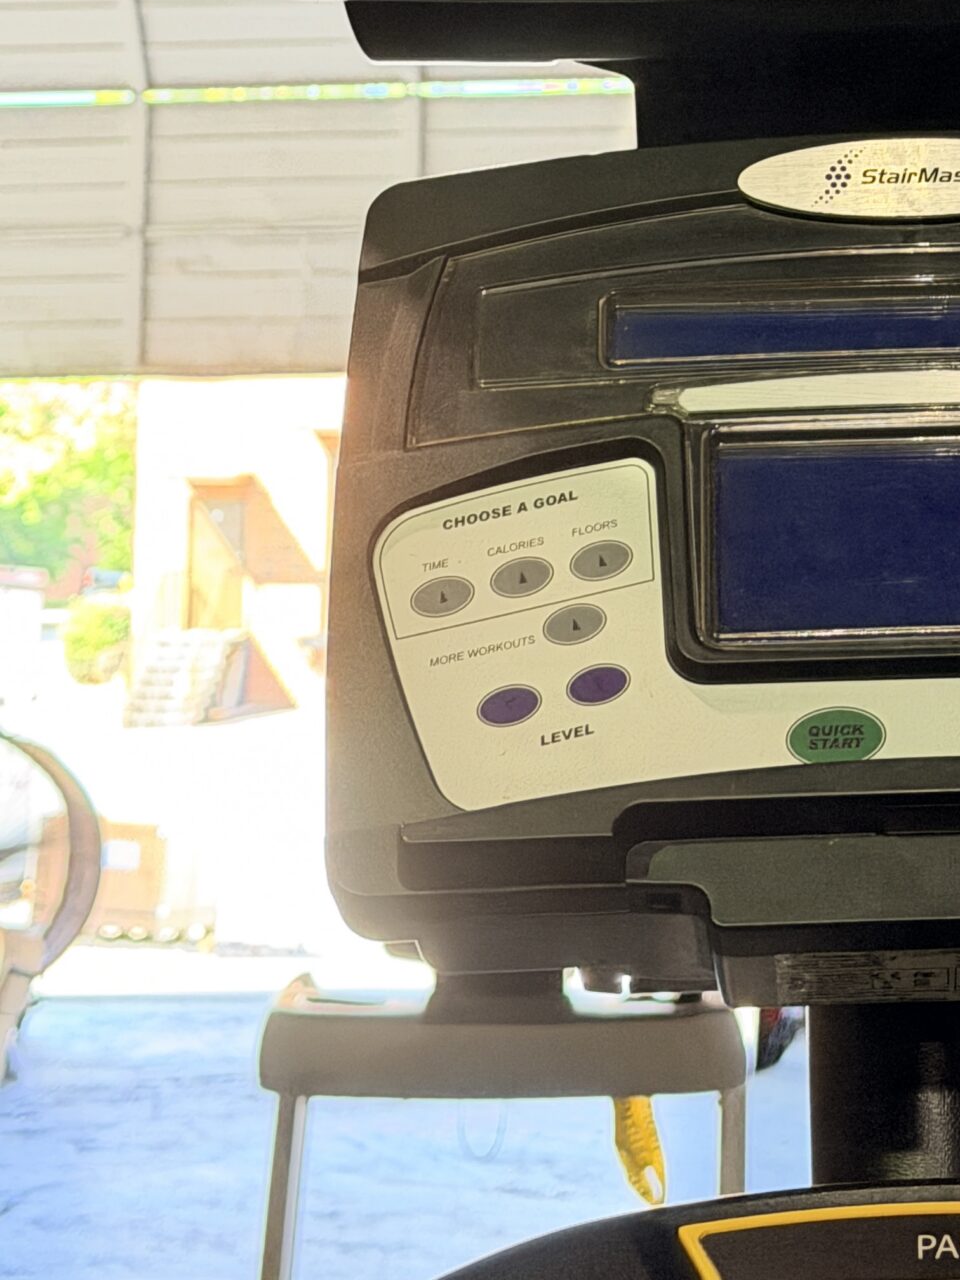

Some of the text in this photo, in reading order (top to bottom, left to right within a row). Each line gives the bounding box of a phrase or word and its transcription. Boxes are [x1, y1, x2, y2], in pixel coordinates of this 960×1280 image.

[442, 489, 579, 531] CHOOSE A GOAL
[571, 519, 619, 538] FLOORS
[486, 536, 545, 558] CALORIES
[421, 557, 450, 573] TIME
[429, 634, 536, 668] MORE WORKOUTS
[540, 723, 596, 747] LEVEL
[807, 724, 865, 738] QUICK
[808, 737, 865, 750] START
